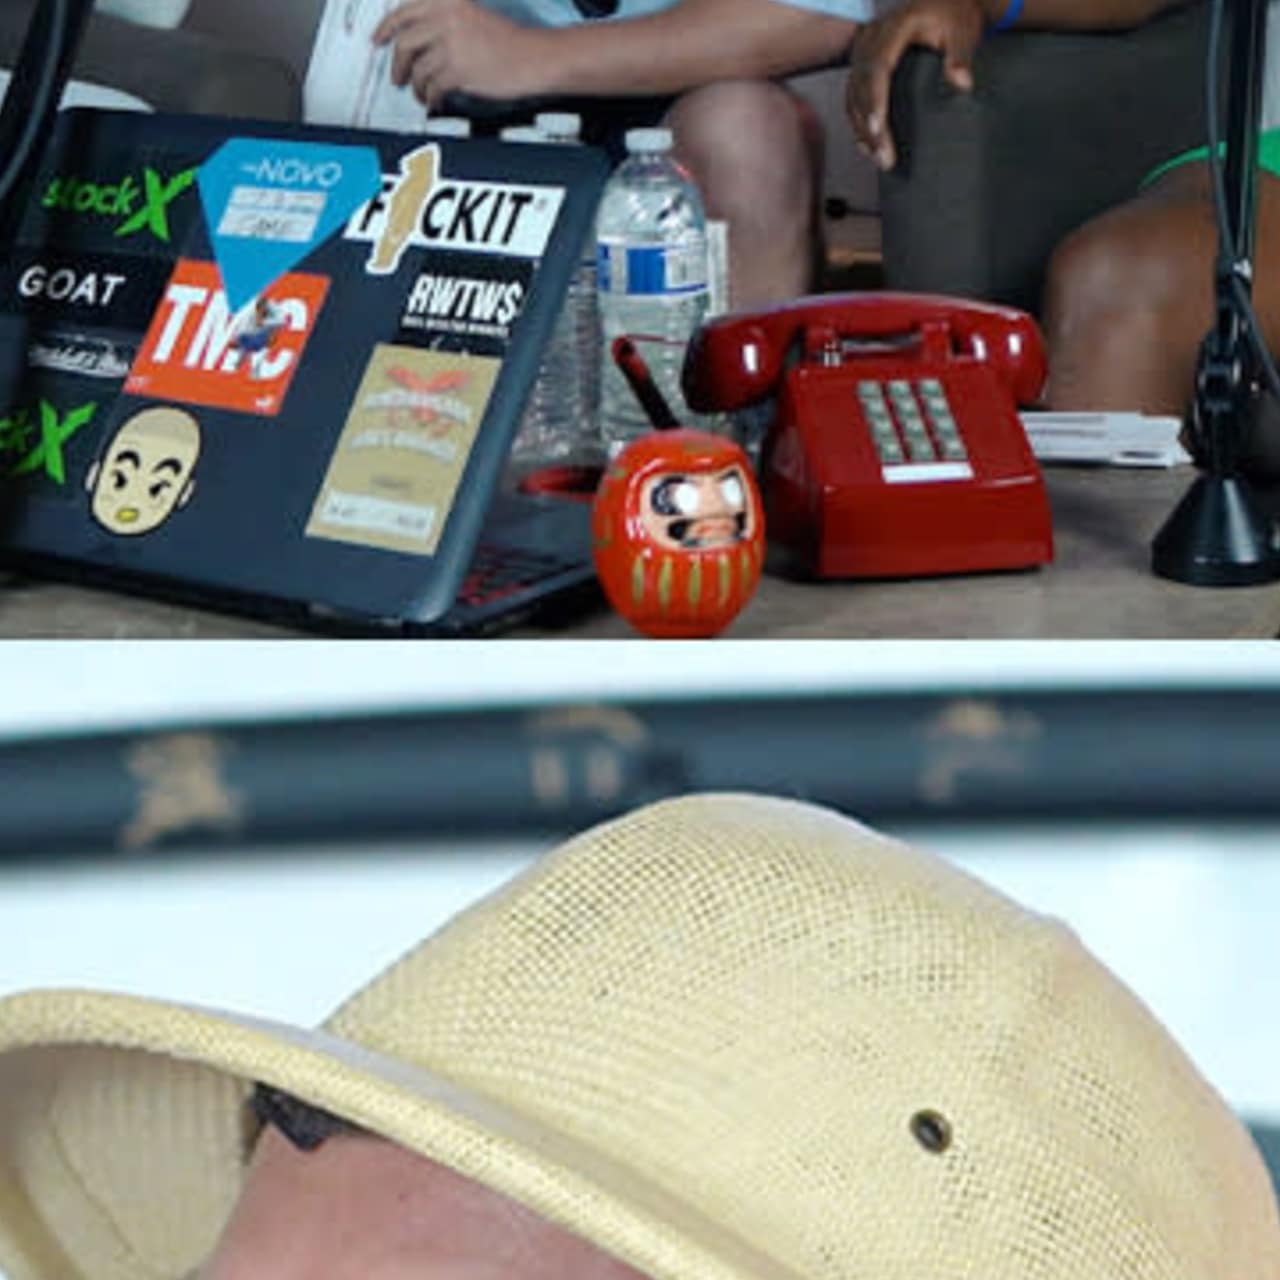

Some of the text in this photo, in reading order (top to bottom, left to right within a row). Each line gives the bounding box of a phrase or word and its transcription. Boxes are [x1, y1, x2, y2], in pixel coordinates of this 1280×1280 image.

[256, 157, 342, 188] NOVO
[358, 180, 535, 247] FCKIT
[18, 265, 126, 306] GOAT
[151, 283, 308, 381] TMC
